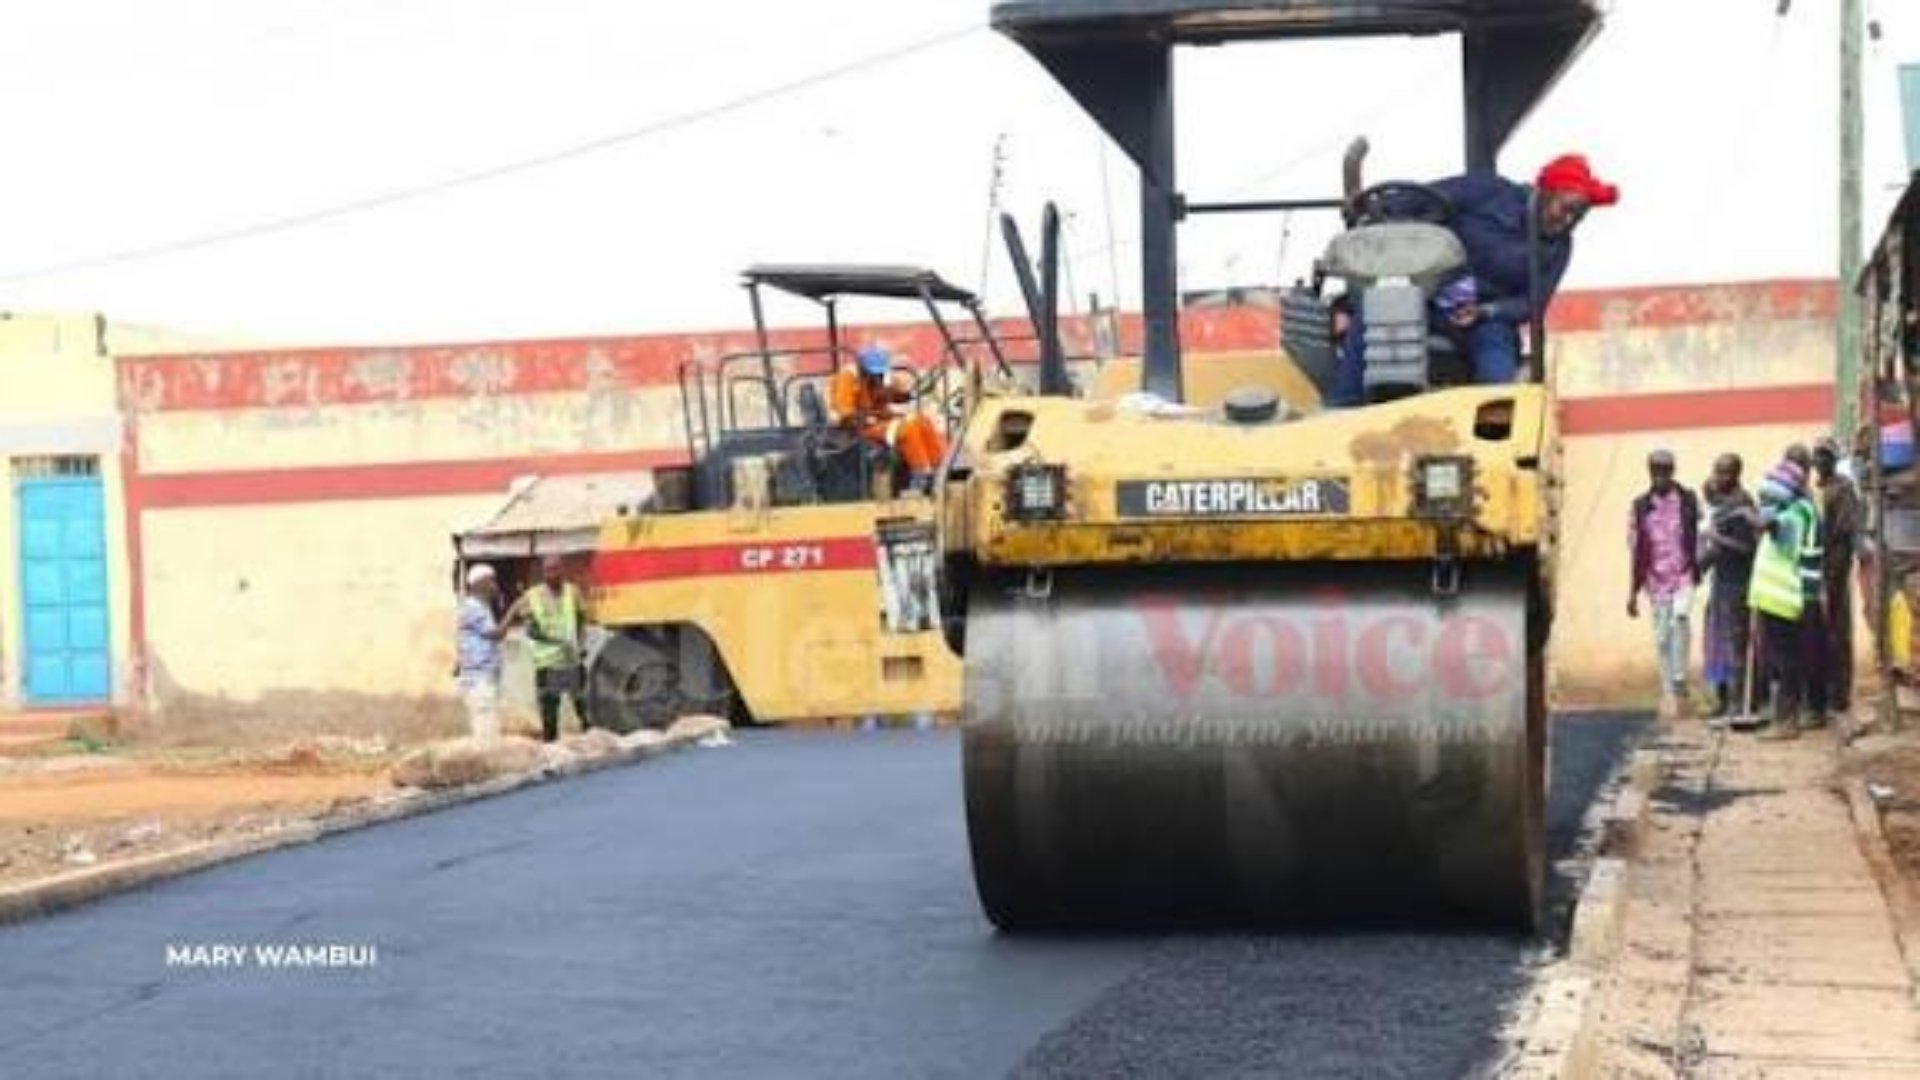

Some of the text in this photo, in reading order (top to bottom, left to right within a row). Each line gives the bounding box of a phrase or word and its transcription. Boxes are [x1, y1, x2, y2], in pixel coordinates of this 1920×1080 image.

[1145, 479, 1321, 513] CATERPILLAR
[741, 546, 823, 569] CP 271
